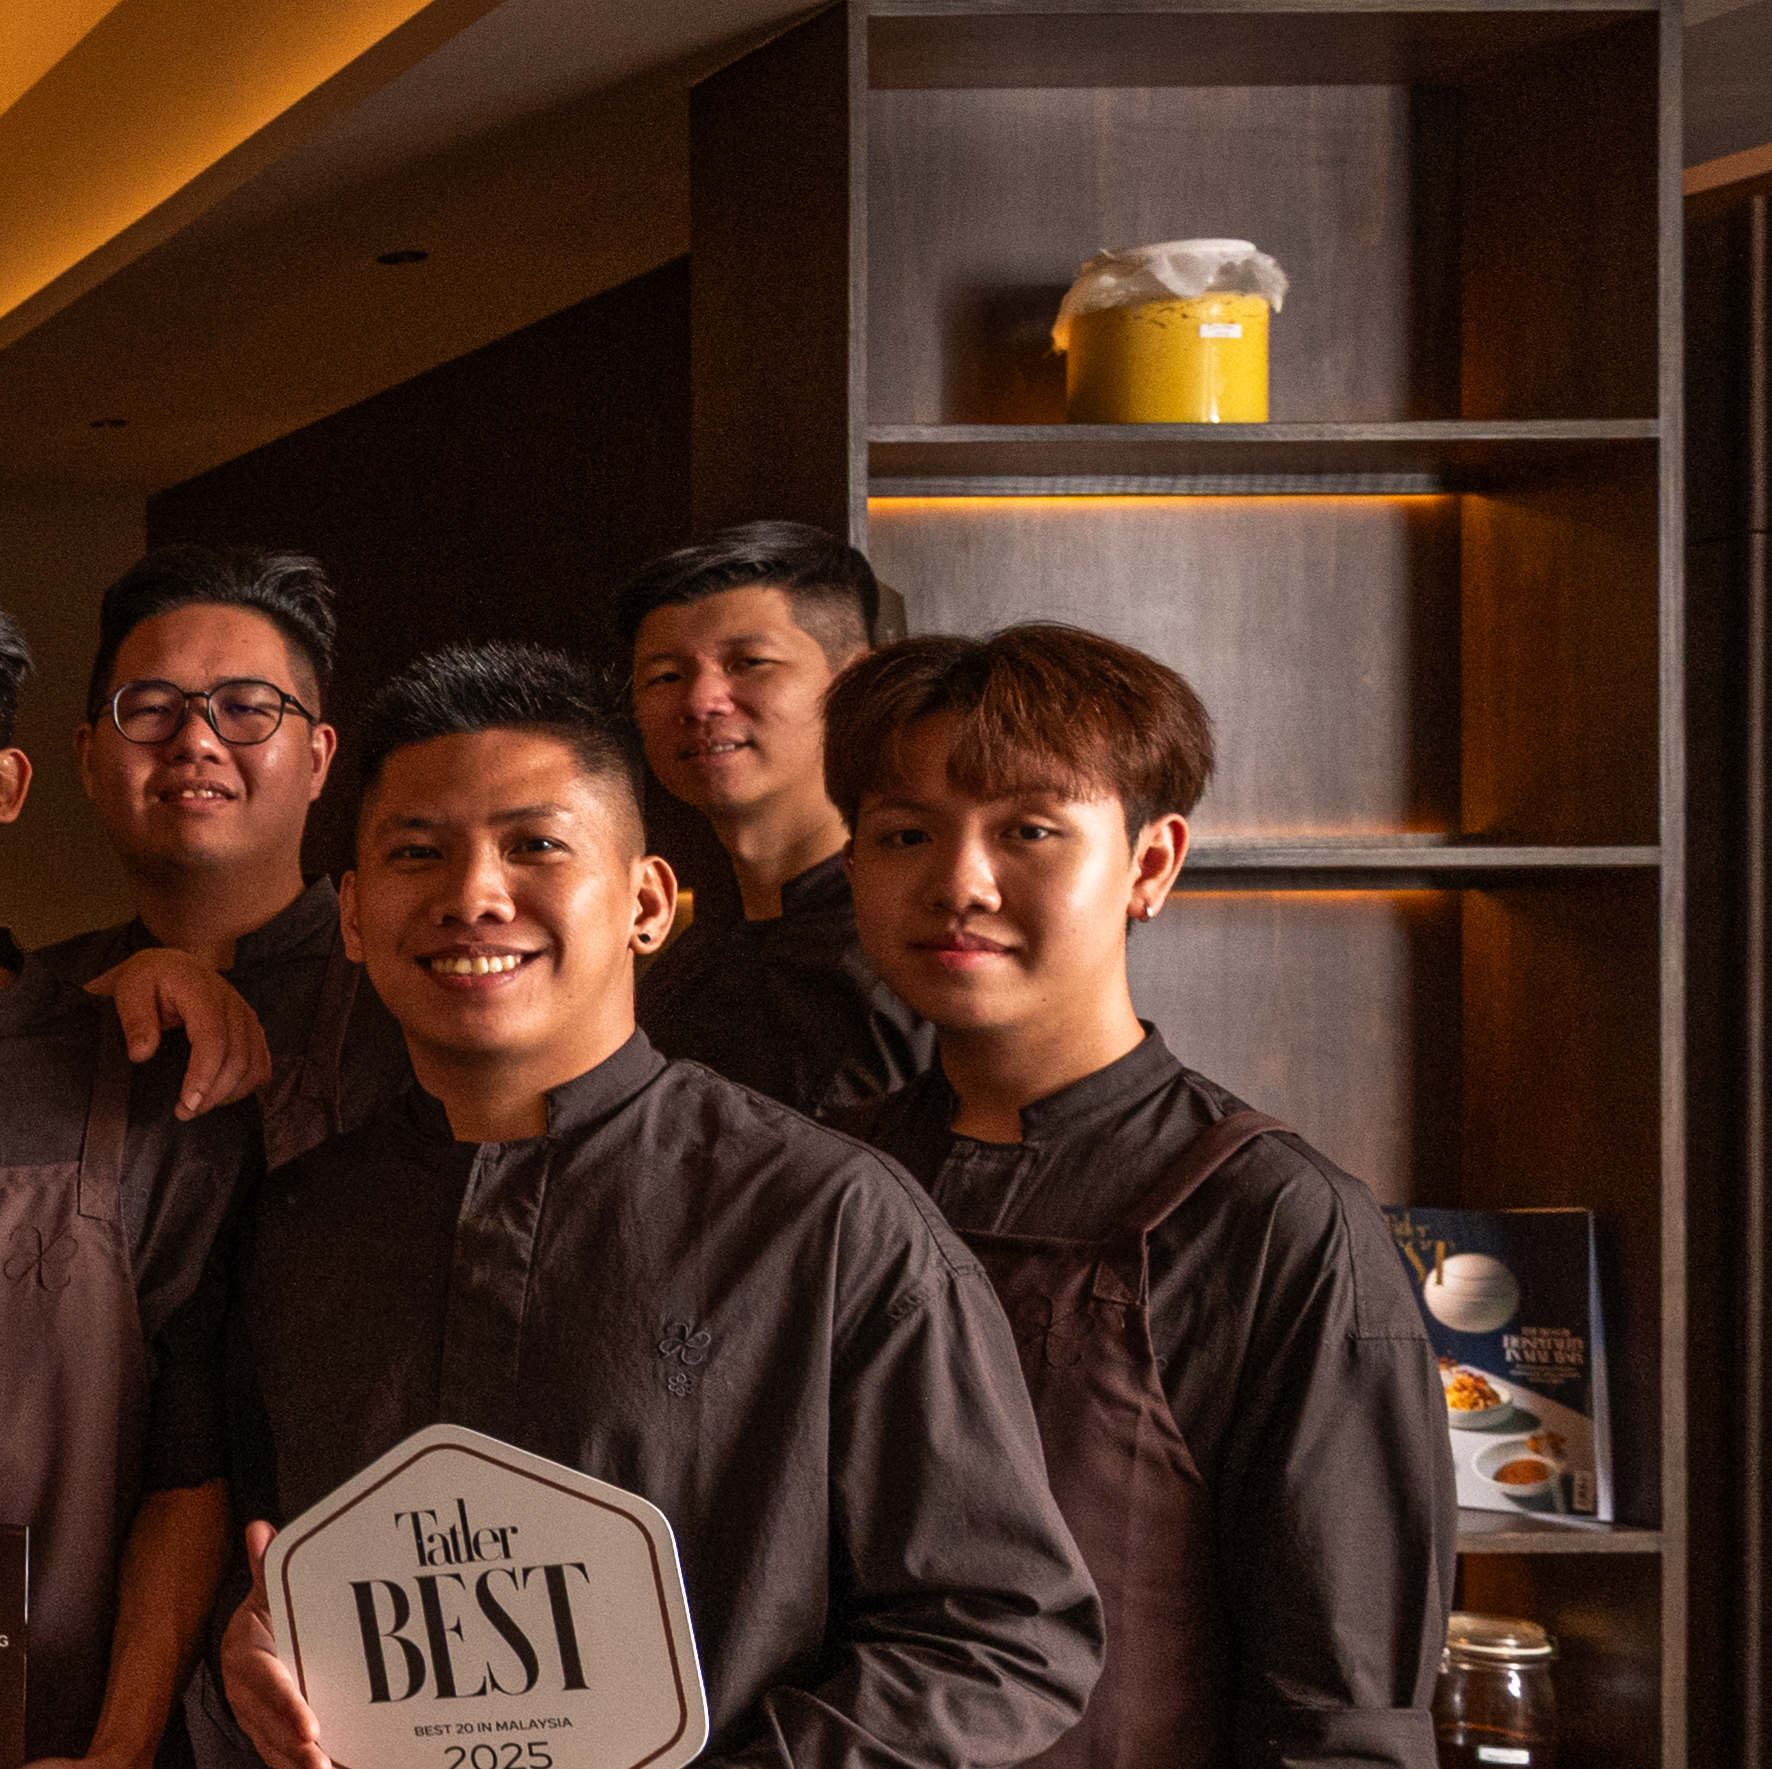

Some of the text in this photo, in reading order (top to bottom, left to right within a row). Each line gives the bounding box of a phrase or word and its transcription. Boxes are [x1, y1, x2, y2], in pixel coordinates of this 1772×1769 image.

[394, 1498, 518, 1567] Tatler
[348, 1562, 591, 1703] BEST
[414, 1716, 573, 1738] BEST 20 IN MALAYSIA
